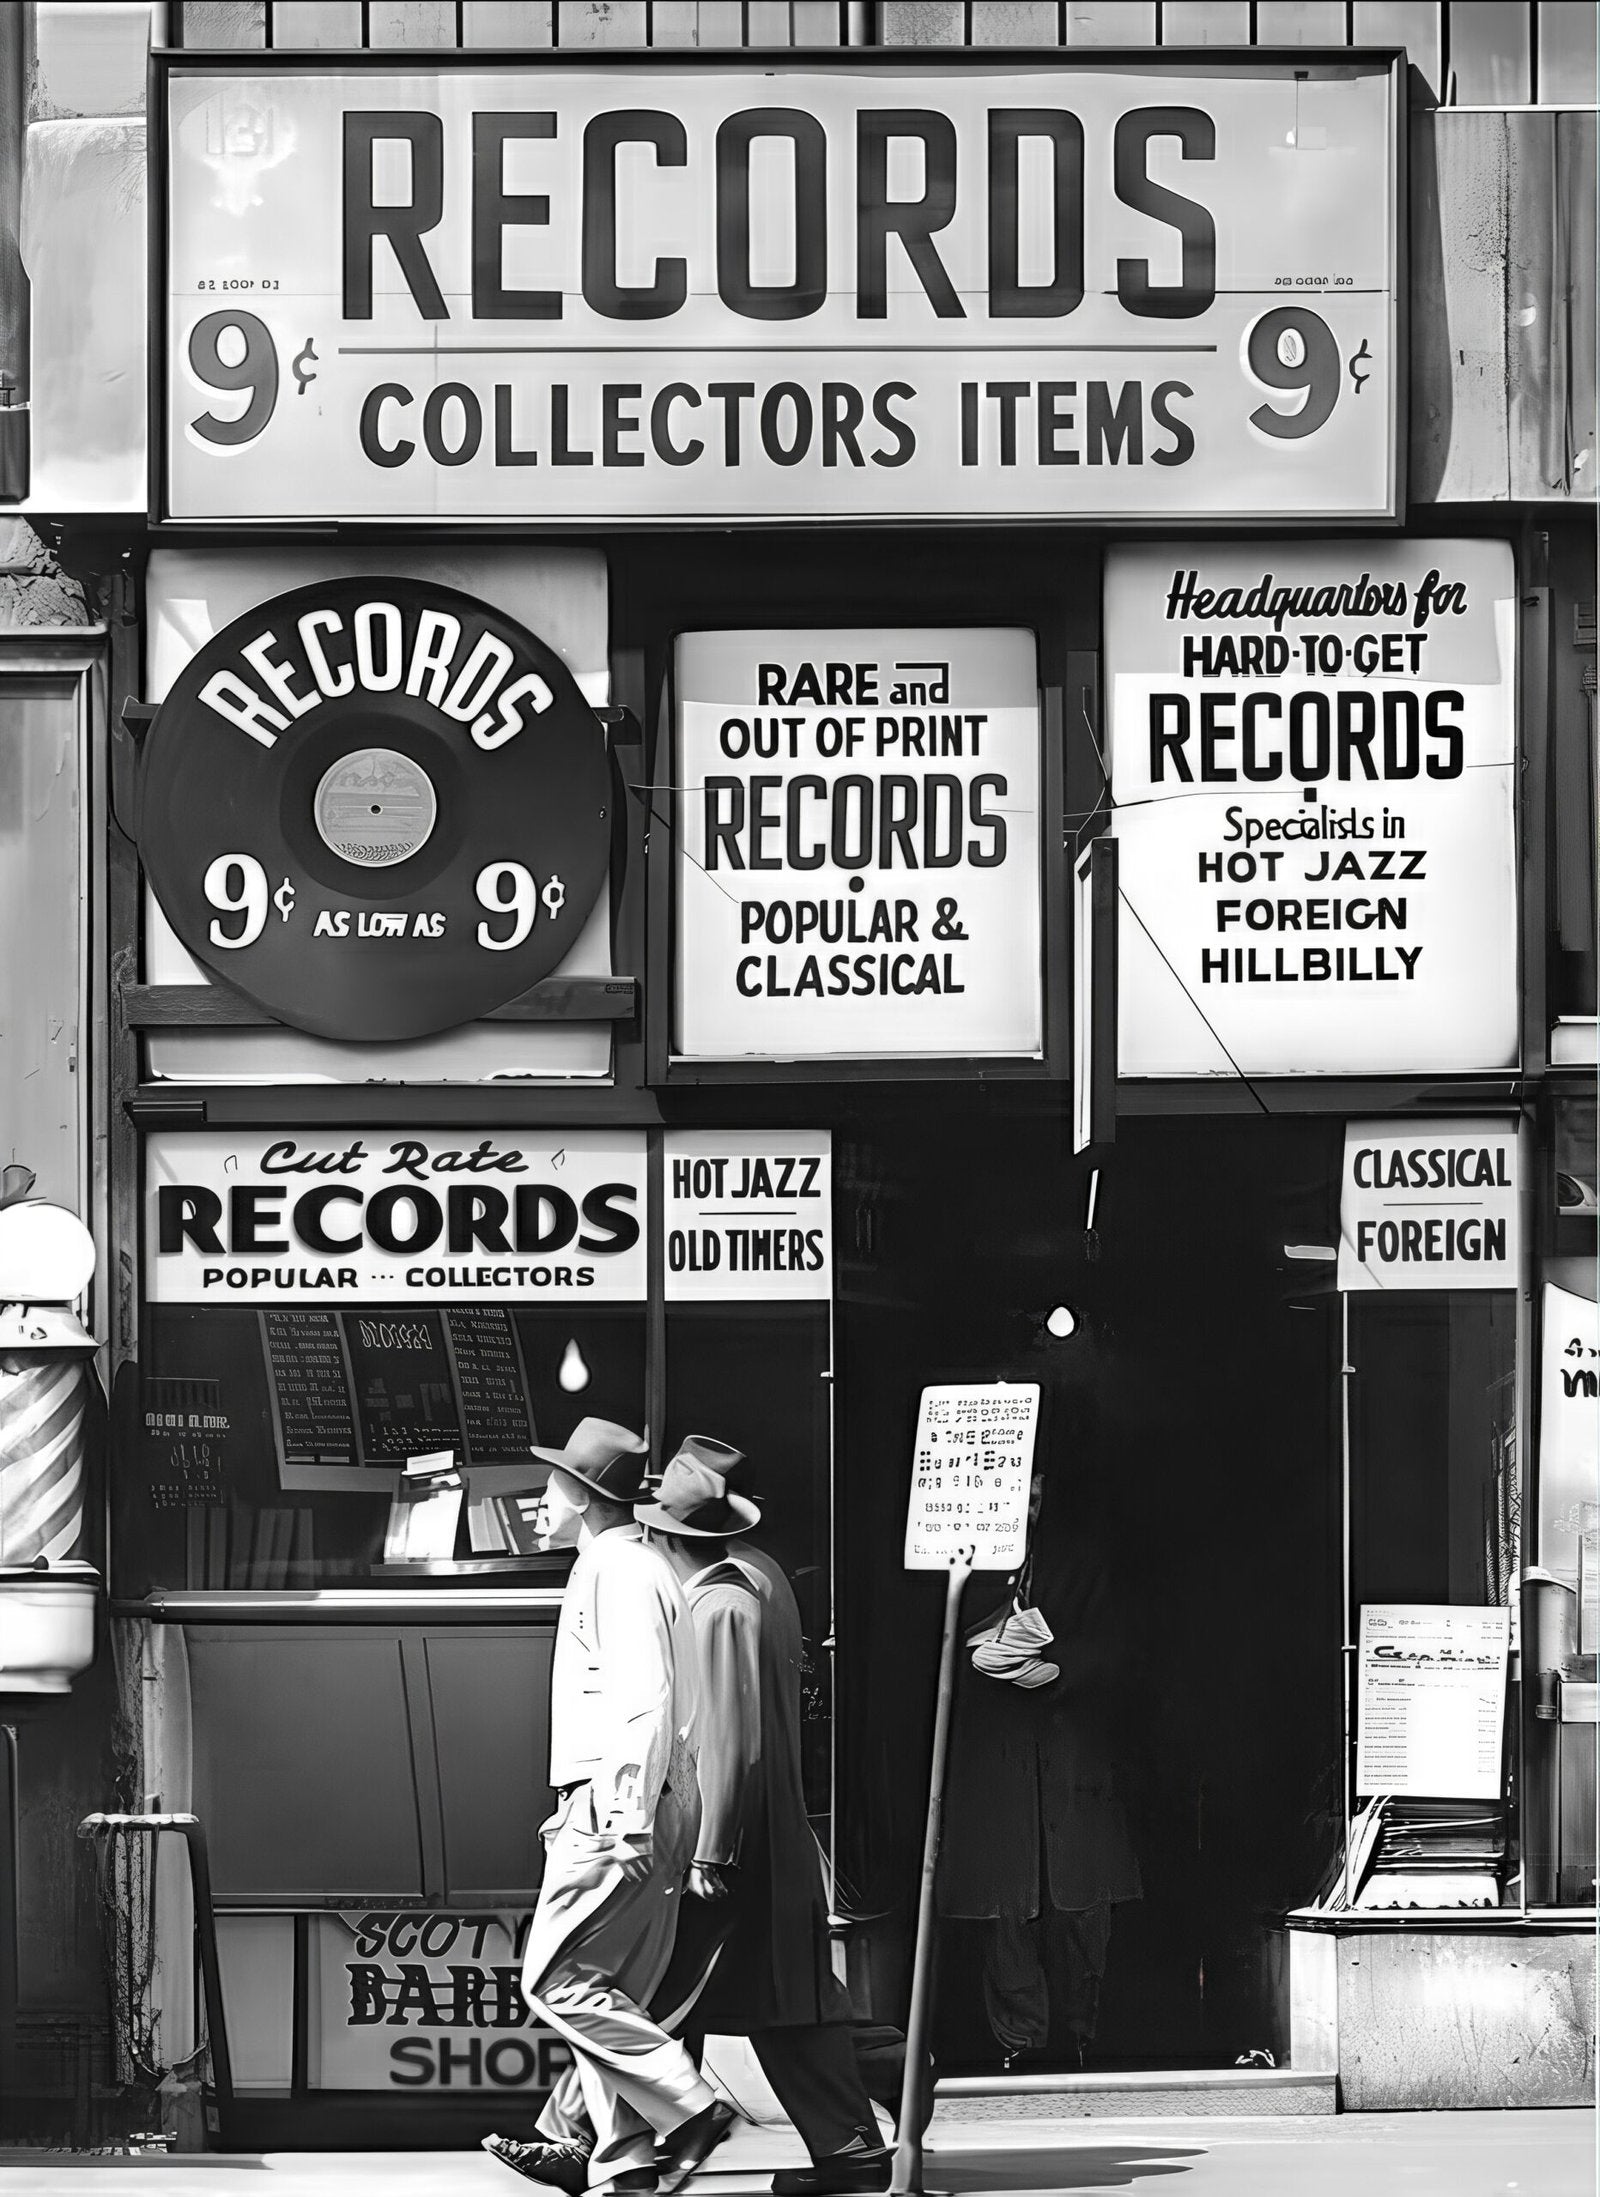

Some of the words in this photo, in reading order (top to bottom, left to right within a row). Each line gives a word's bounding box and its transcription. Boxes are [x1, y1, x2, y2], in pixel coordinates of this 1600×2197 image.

[343, 106, 1216, 321] RECORDS
[359, 381, 918, 469] COLLECTORS
[961, 380, 1195, 467] ITEMS
[1413, 569, 1468, 629] for
[198, 602, 554, 751] RECORDS
[758, 662, 879, 706] RARE
[889, 662, 949, 706] and
[719, 717, 806, 760] OUT
[815, 717, 866, 758] OF
[876, 715, 988, 757] PRINT
[1149, 689, 1465, 784] RECORDS
[703, 774, 1008, 871] RECORDS
[1382, 806, 1405, 839] in
[1198, 851, 1285, 883] HOT
[1304, 850, 1427, 882] JAZZ
[313, 910, 351, 937] AS
[412, 912, 446, 937] AS
[741, 899, 919, 944] POPULAR
[931, 897, 969, 941] &
[1216, 897, 1407, 933] FOREIGN
[736, 953, 965, 998] CLASSICAL
[1201, 946, 1423, 984] HILLBILLY
[260, 1140, 369, 1175] Cut
[382, 1140, 530, 1181] Rate
[673, 1158, 729, 1199] HOT
[731, 1157, 821, 1198] JAZZ
[1353, 1148, 1512, 1189] CLASSICAL
[158, 1183, 640, 1254] RECORDS
[1357, 1218, 1506, 1263] FOREIGN
[668, 1229, 721, 1272] OLD
[203, 1267, 359, 1289] POPULAR
[345, 1964, 553, 2028] BARB
[390, 2037, 577, 2087] SHOP
